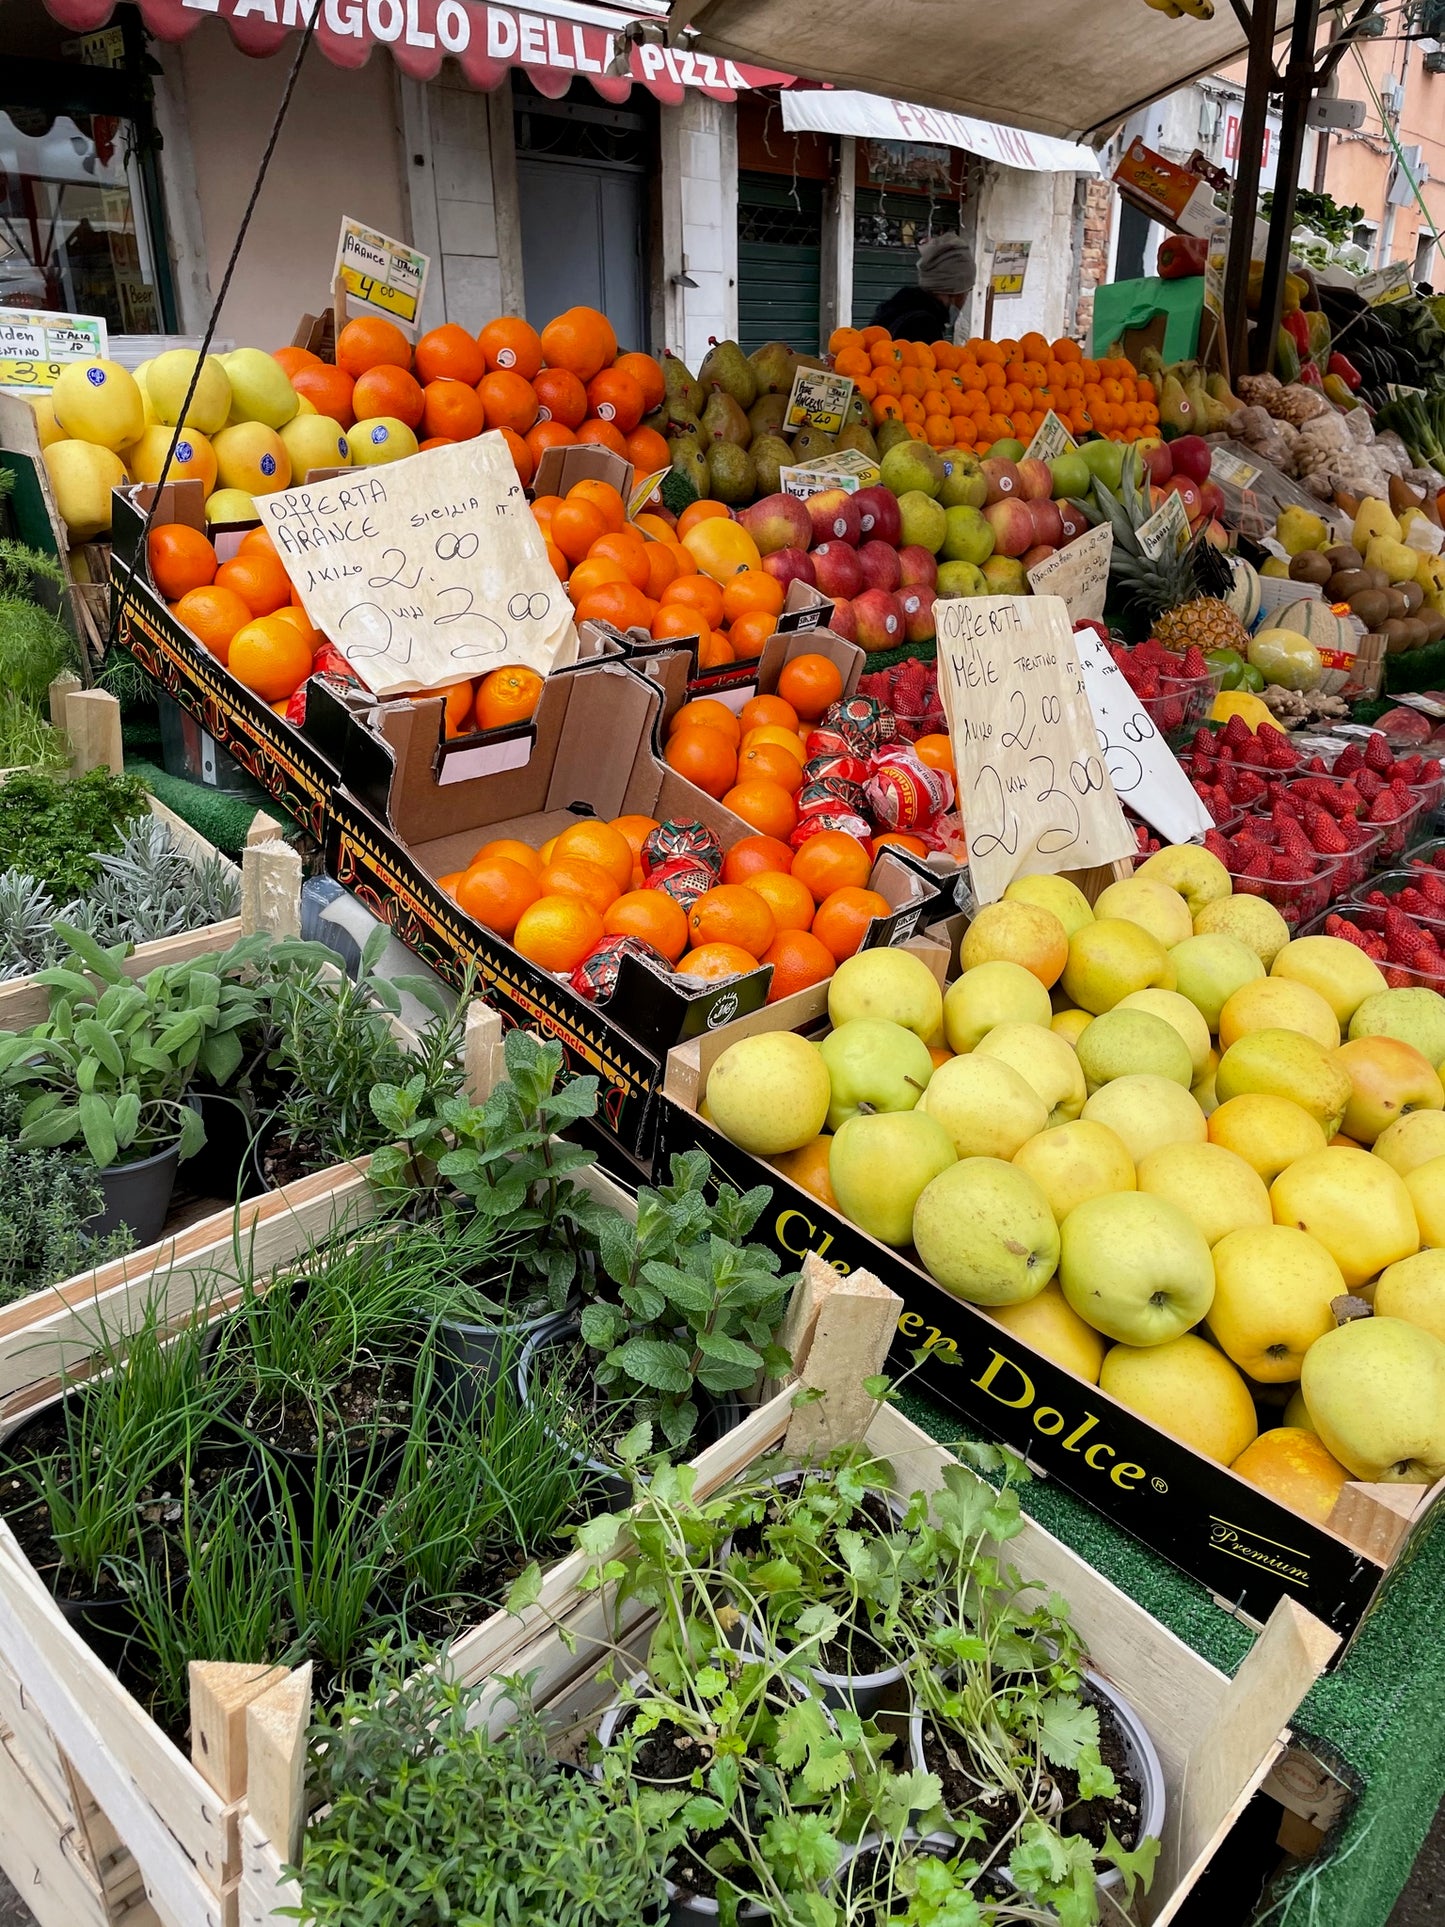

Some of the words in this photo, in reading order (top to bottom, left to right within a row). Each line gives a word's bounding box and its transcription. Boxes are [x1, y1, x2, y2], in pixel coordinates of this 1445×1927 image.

[639, 43, 750, 89] PIZZA
[347, 235, 385, 266] ARANCE
[56, 330, 91, 342] ITALIA
[270, 478, 388, 528] OFFERTA
[277, 516, 380, 554] ARANCE
[410, 498, 479, 527] SICILIA
[943, 603, 1023, 660] OFFERTA
[1013, 653, 1057, 673] TRENTINO
[394, 884, 436, 929] d'arancia
[510, 988, 532, 1011] Fior
[534, 1008, 586, 1056] d'arancia
[775, 1209, 959, 1354] Cleen
[1210, 1522, 1310, 1580] Premium
